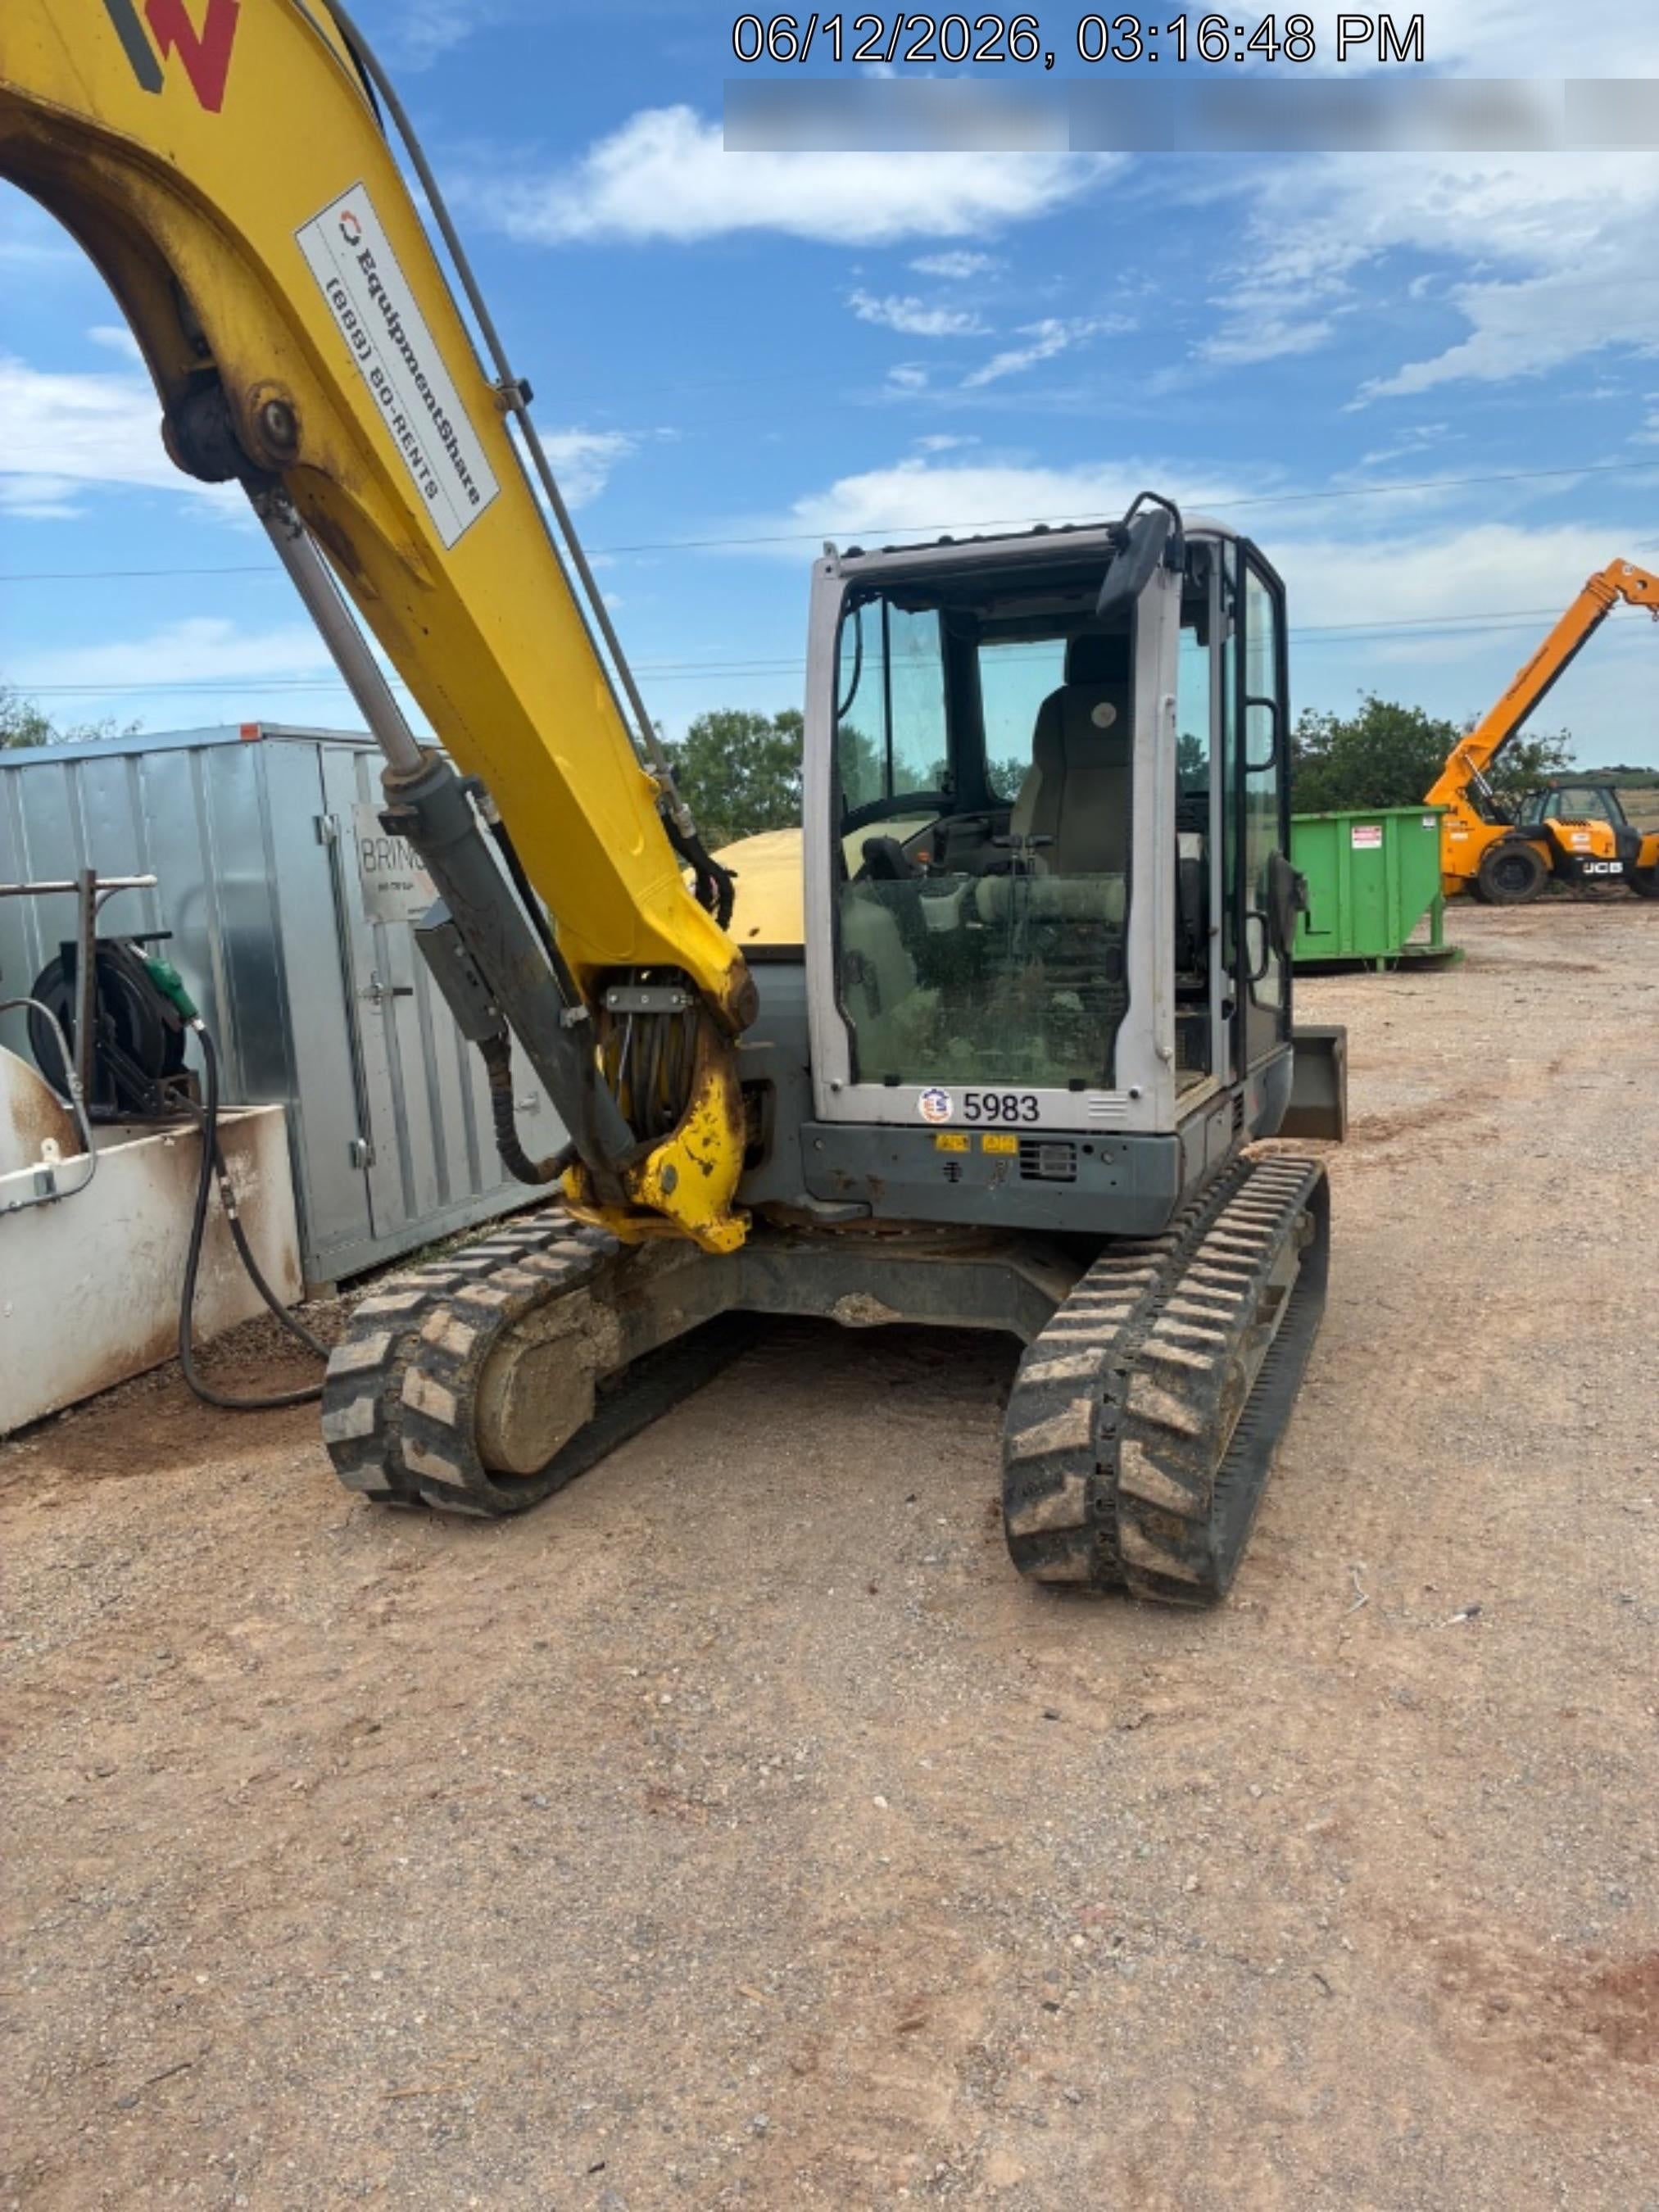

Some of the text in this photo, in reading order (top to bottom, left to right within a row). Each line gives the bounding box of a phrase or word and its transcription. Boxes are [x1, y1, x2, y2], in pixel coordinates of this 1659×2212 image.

[326, 276, 438, 501] (888) 80-RENTS
[356, 247, 482, 506] EquipmentShare
[1583, 862, 1623, 874] JCB
[963, 1092, 1040, 1122] 5983
